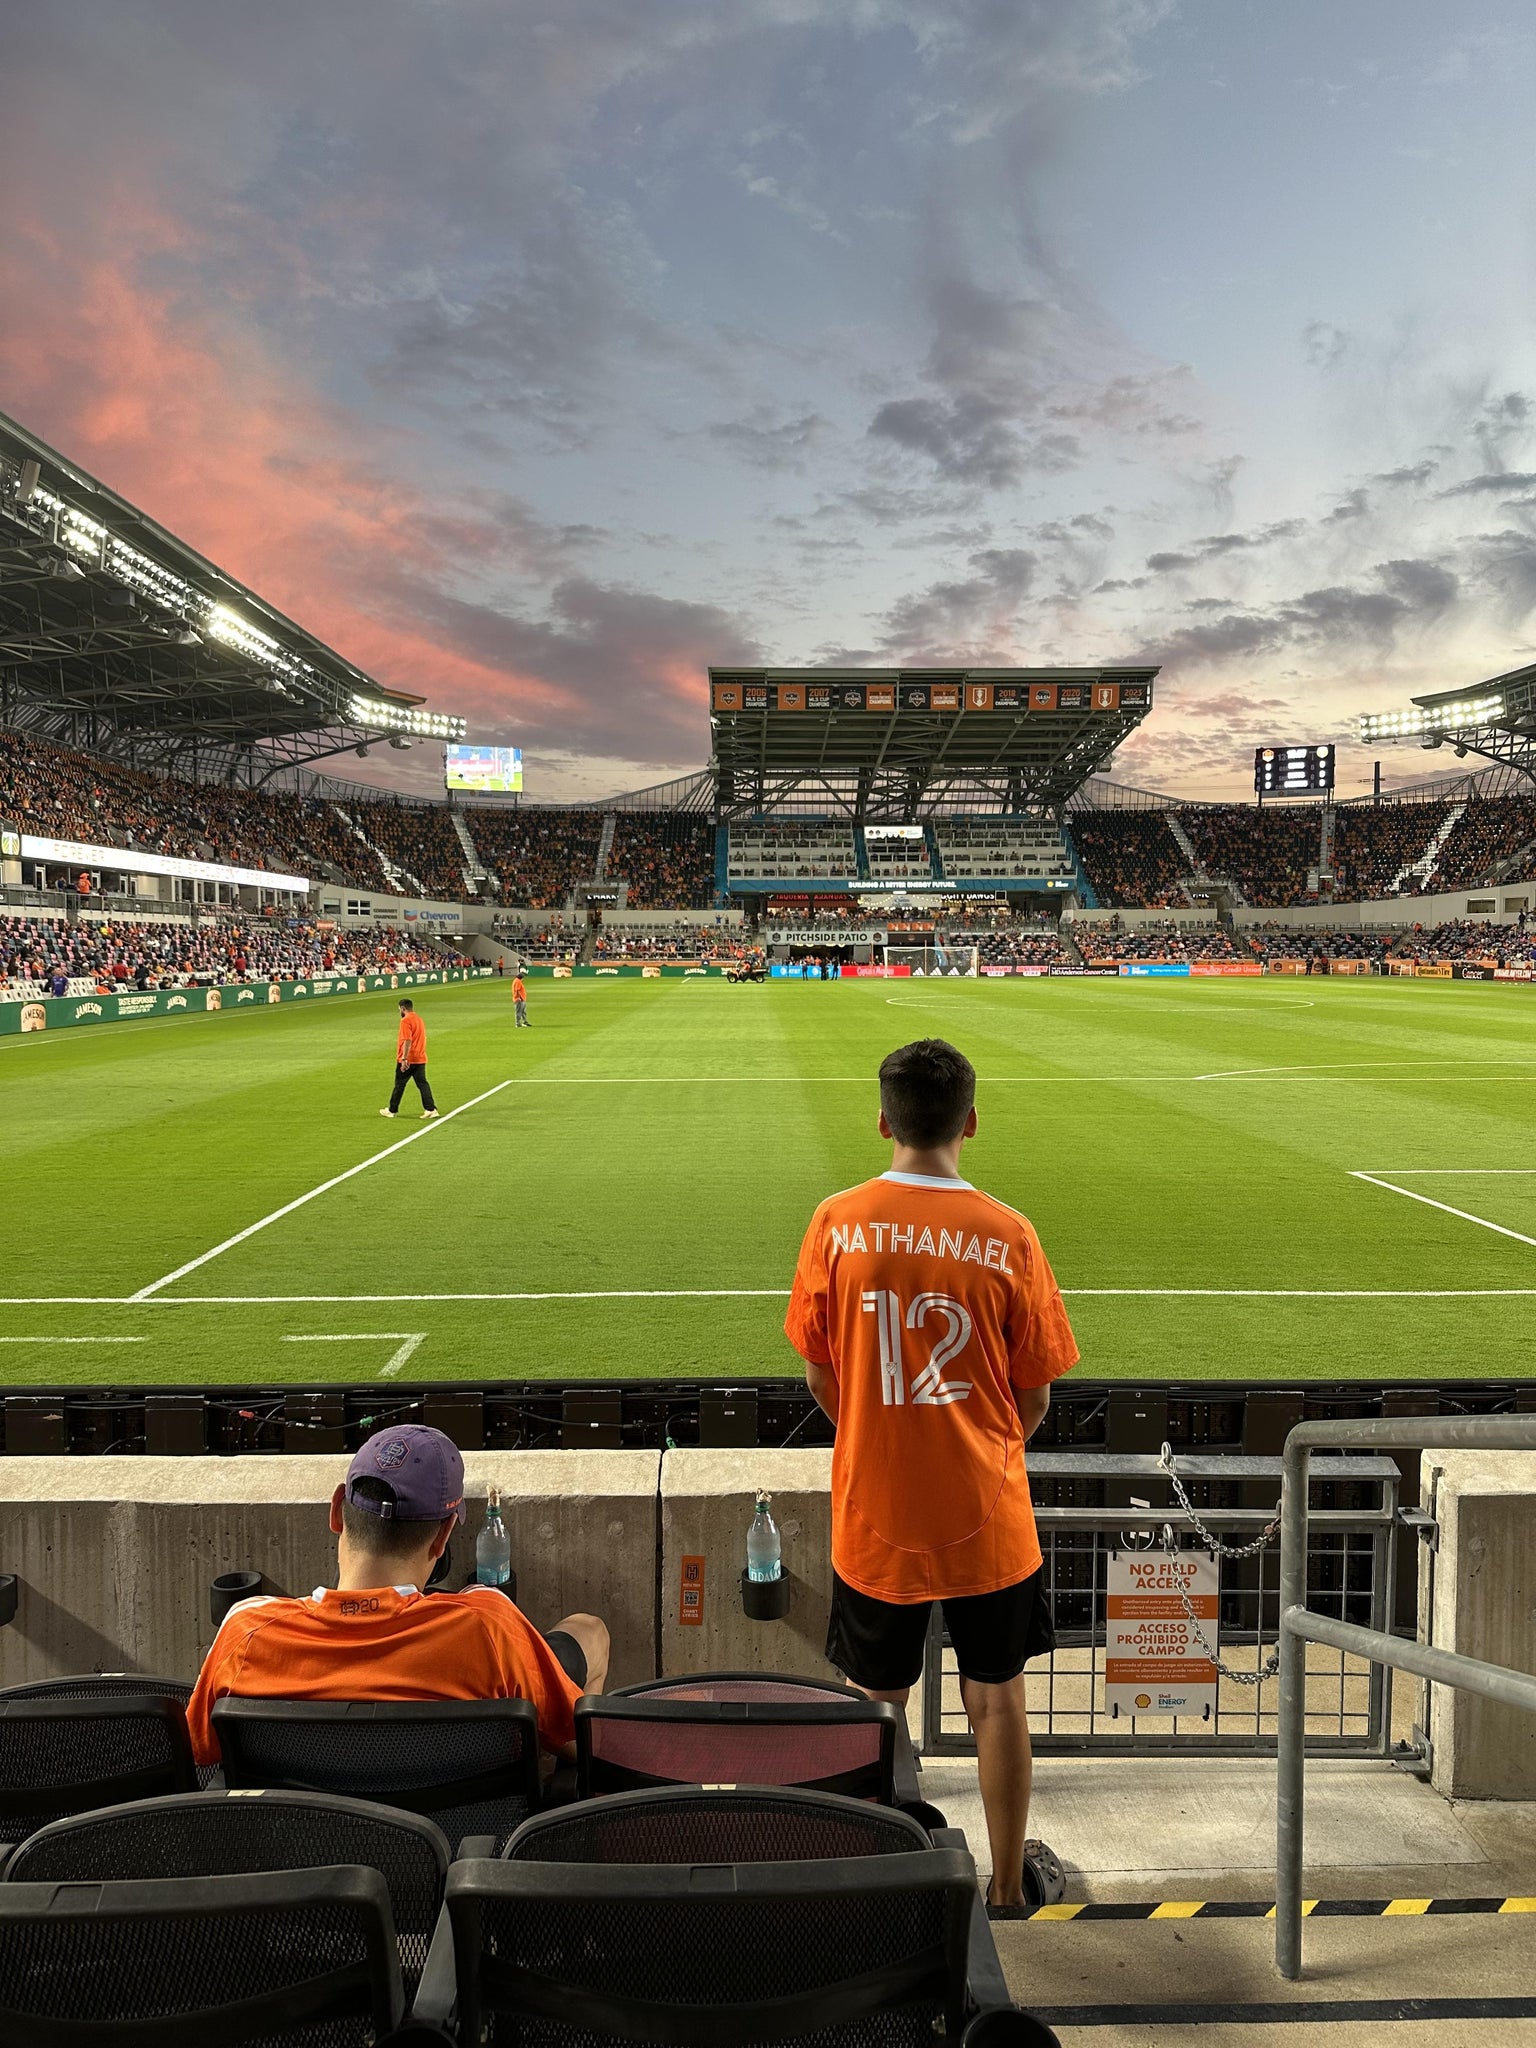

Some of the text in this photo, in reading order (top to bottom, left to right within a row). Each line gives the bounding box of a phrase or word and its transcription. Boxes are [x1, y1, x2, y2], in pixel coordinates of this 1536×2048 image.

[746, 688, 766, 696] 2006
[809, 688, 829, 696] 2007
[420, 911, 460, 920] Chevron
[1462, 968, 1484, 979] Cancer
[167, 996, 187, 1010] JAMESON
[75, 1002, 103, 1019] JAMESON
[832, 1222, 1013, 1275] NATHANAEL
[862, 1290, 973, 1405] 12
[1130, 1564, 1154, 1575] NO
[360, 1598, 379, 1613] 20
[1138, 1624, 1186, 1633] ACCESO
[1117, 1635, 1189, 1644] PROHIBIDO
[1138, 1646, 1185, 1655] CAMPO
